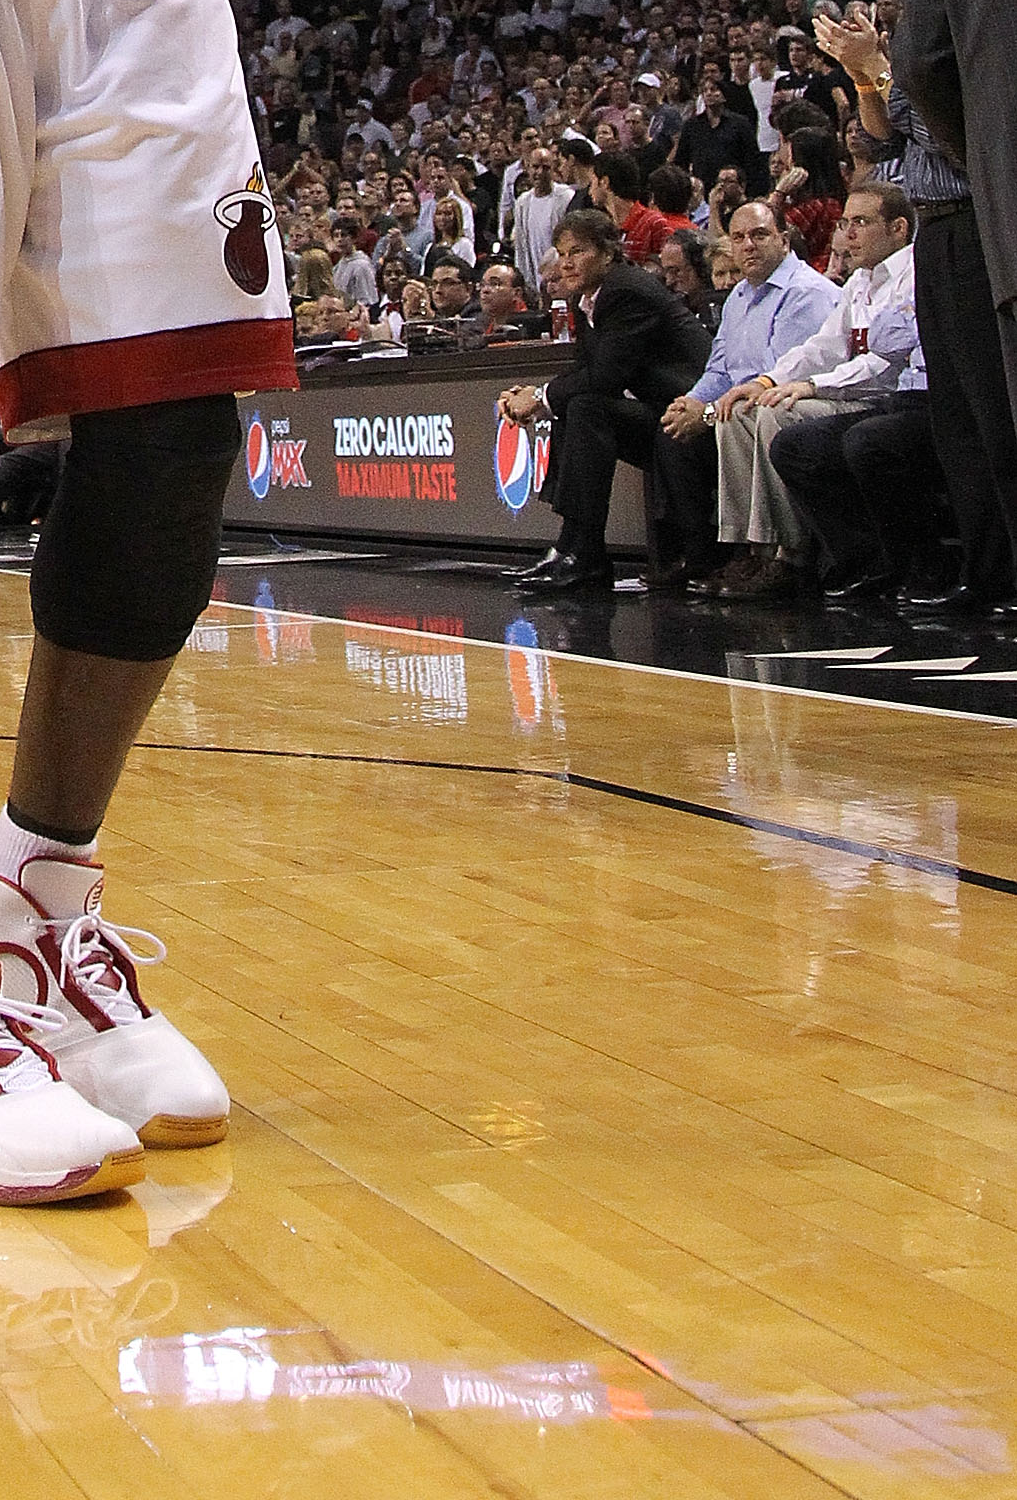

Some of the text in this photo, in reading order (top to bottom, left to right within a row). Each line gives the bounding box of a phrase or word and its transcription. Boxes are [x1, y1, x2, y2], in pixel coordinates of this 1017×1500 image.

[333, 414, 455, 457] ZERO CALORIES
[336, 462, 457, 501] MAXIMUM TASTE
